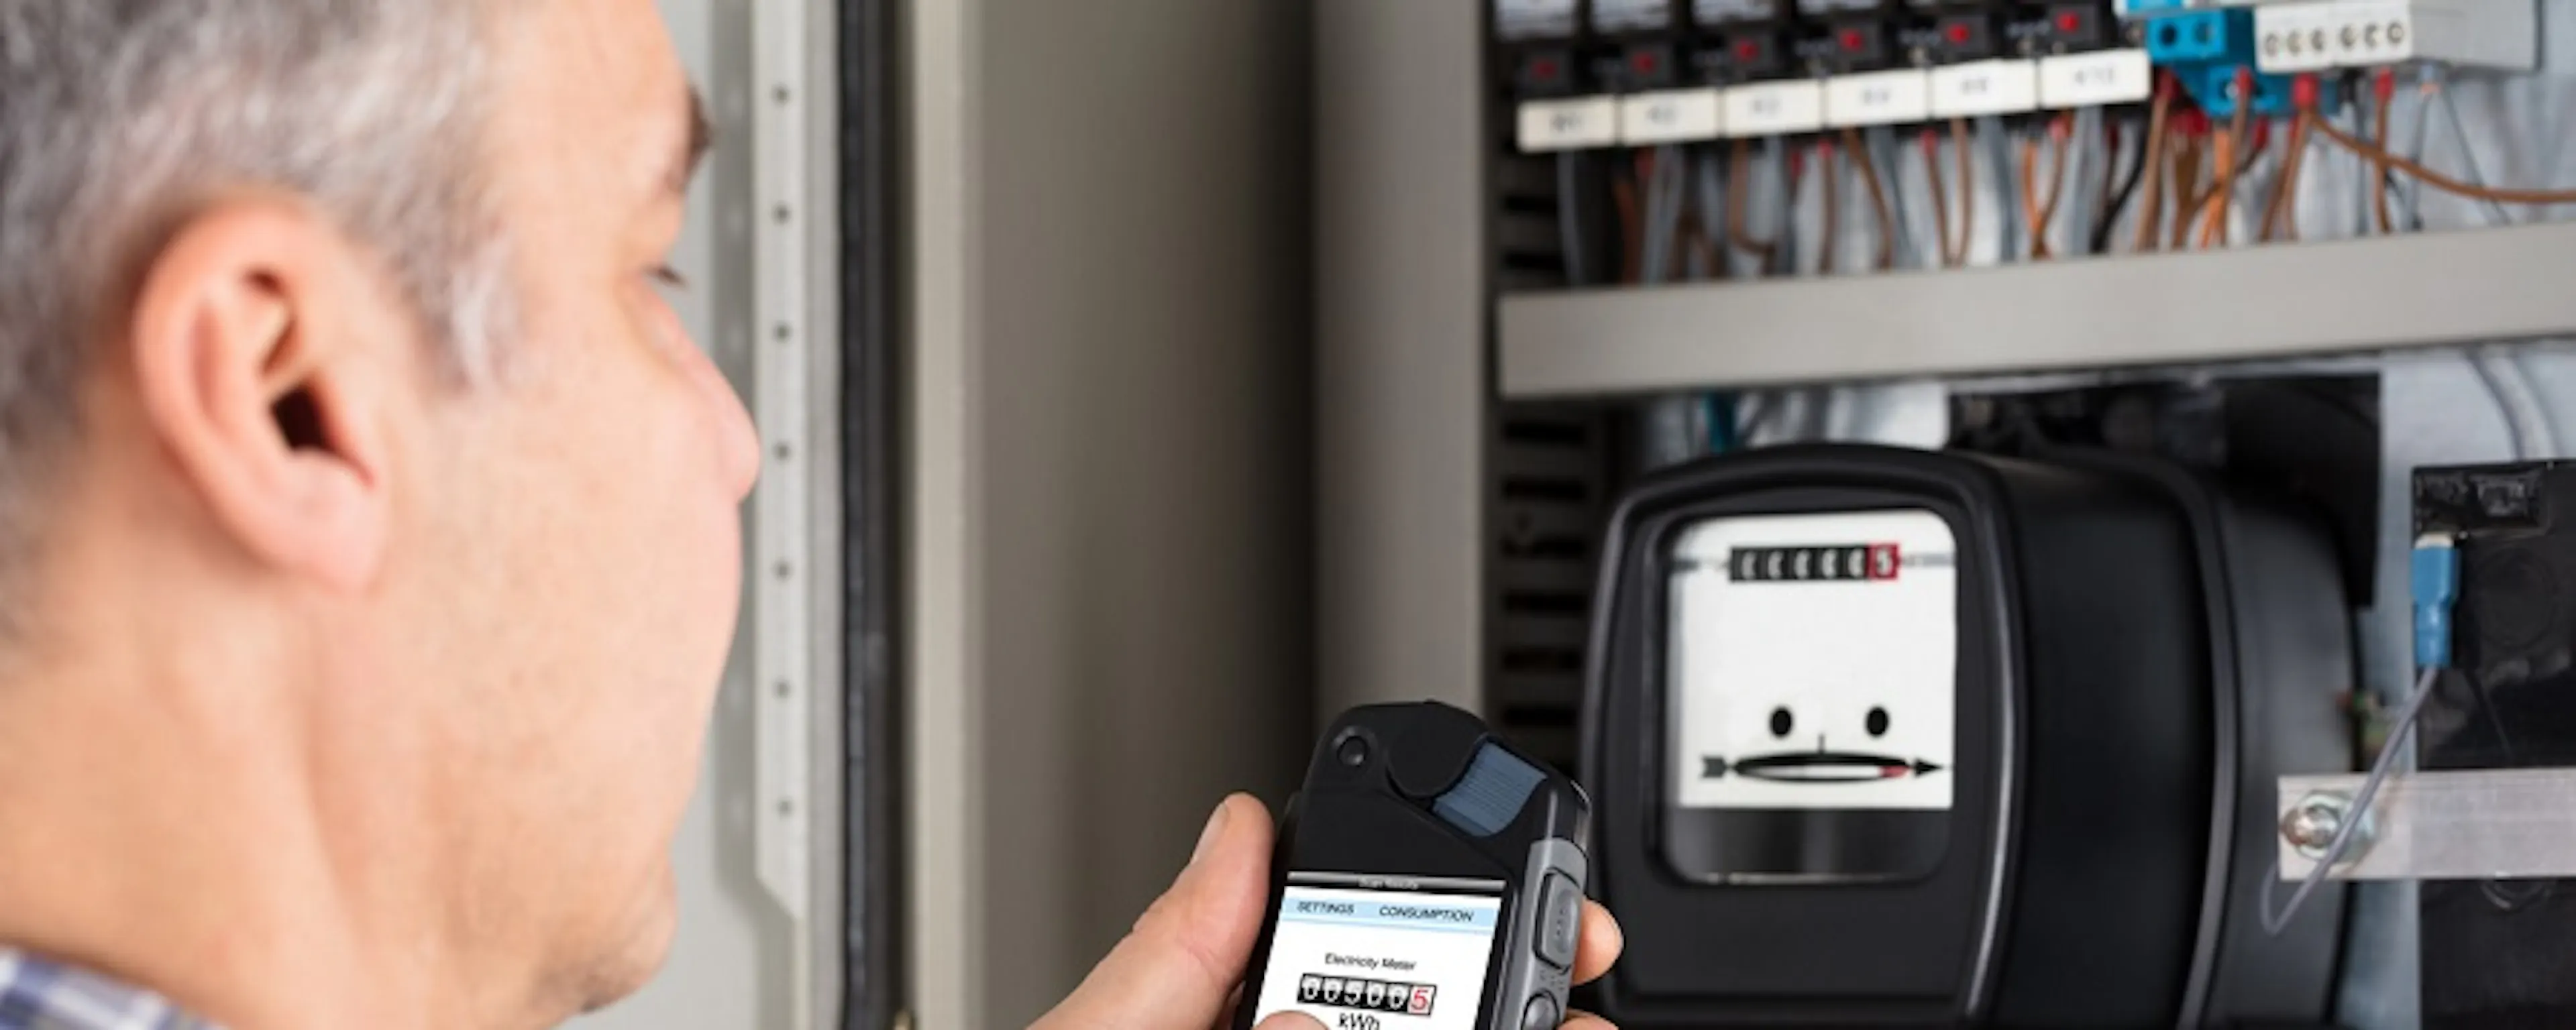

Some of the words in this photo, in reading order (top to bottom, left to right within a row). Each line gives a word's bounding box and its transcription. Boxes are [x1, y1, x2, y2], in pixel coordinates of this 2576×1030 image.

[1297, 901, 1355, 915] SETTINGS
[1379, 904, 1474, 923] CONSUMPTION
[1324, 952, 1379, 970] Electricity
[1382, 958, 1417, 970] Meter
[1300, 974, 1432, 1012] 005005
[1338, 1013, 1380, 1030] kWh
